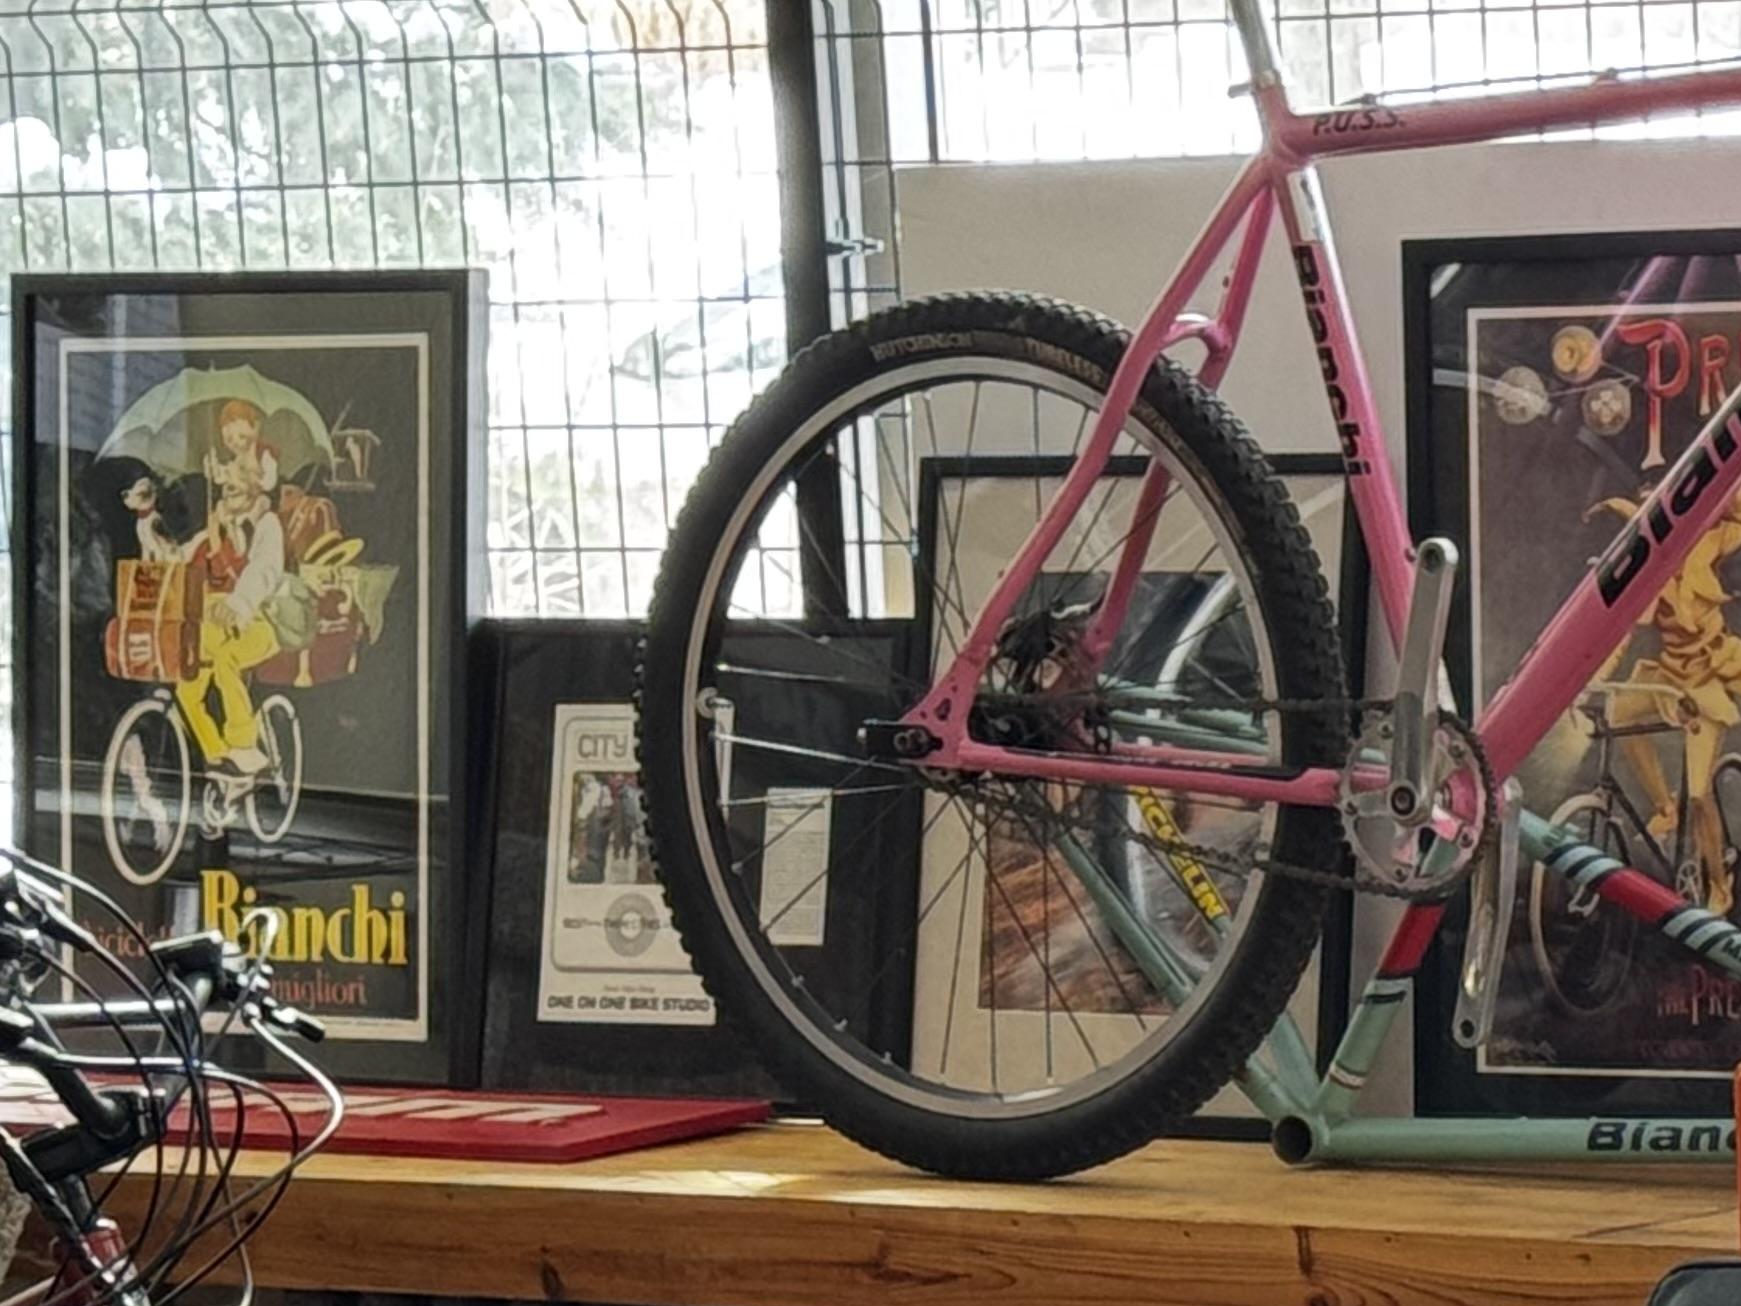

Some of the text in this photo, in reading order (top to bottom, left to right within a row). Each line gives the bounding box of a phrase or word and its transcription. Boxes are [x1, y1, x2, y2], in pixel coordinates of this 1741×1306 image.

[578, 733, 628, 758] CITY
[200, 869, 408, 964] Bianchi
[662, 998, 711, 1012] STUDIO
[1586, 1121, 1736, 1152] Bian
